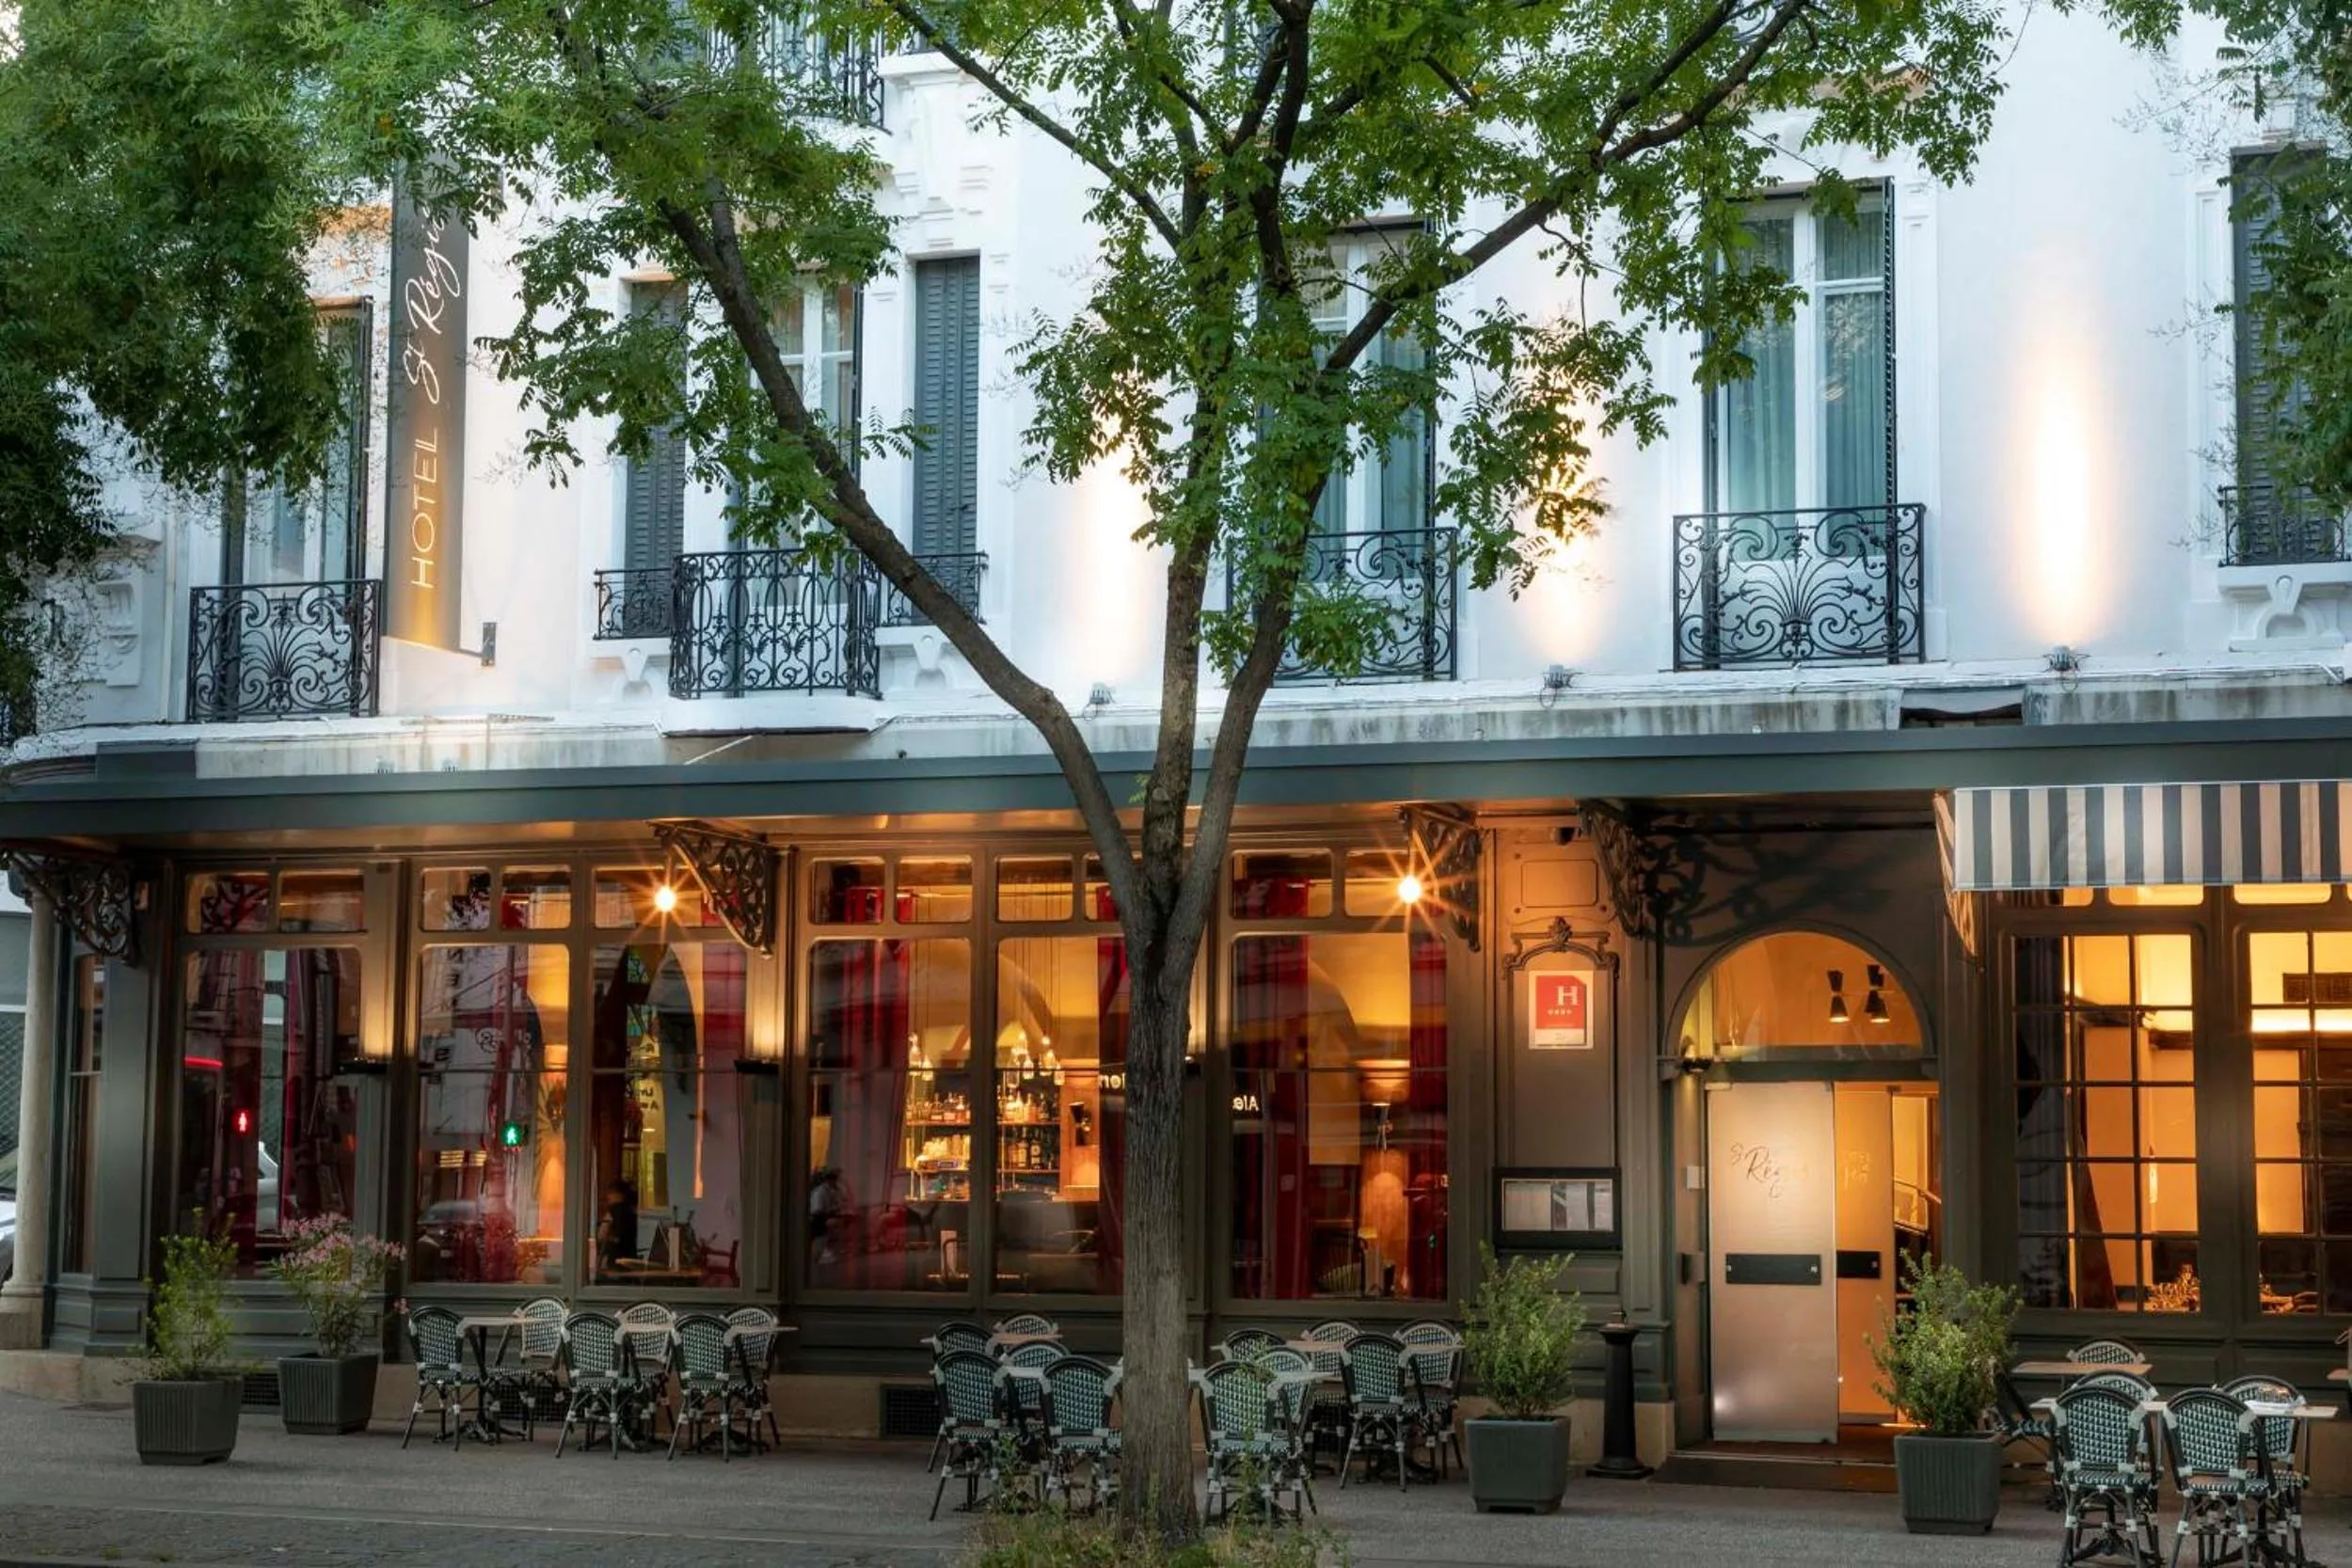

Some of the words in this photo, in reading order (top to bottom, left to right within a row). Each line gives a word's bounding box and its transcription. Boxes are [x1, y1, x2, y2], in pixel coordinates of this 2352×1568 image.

[403, 329, 440, 404] St
[411, 428, 438, 589] HOTEL
[1557, 986, 1579, 1006] H
